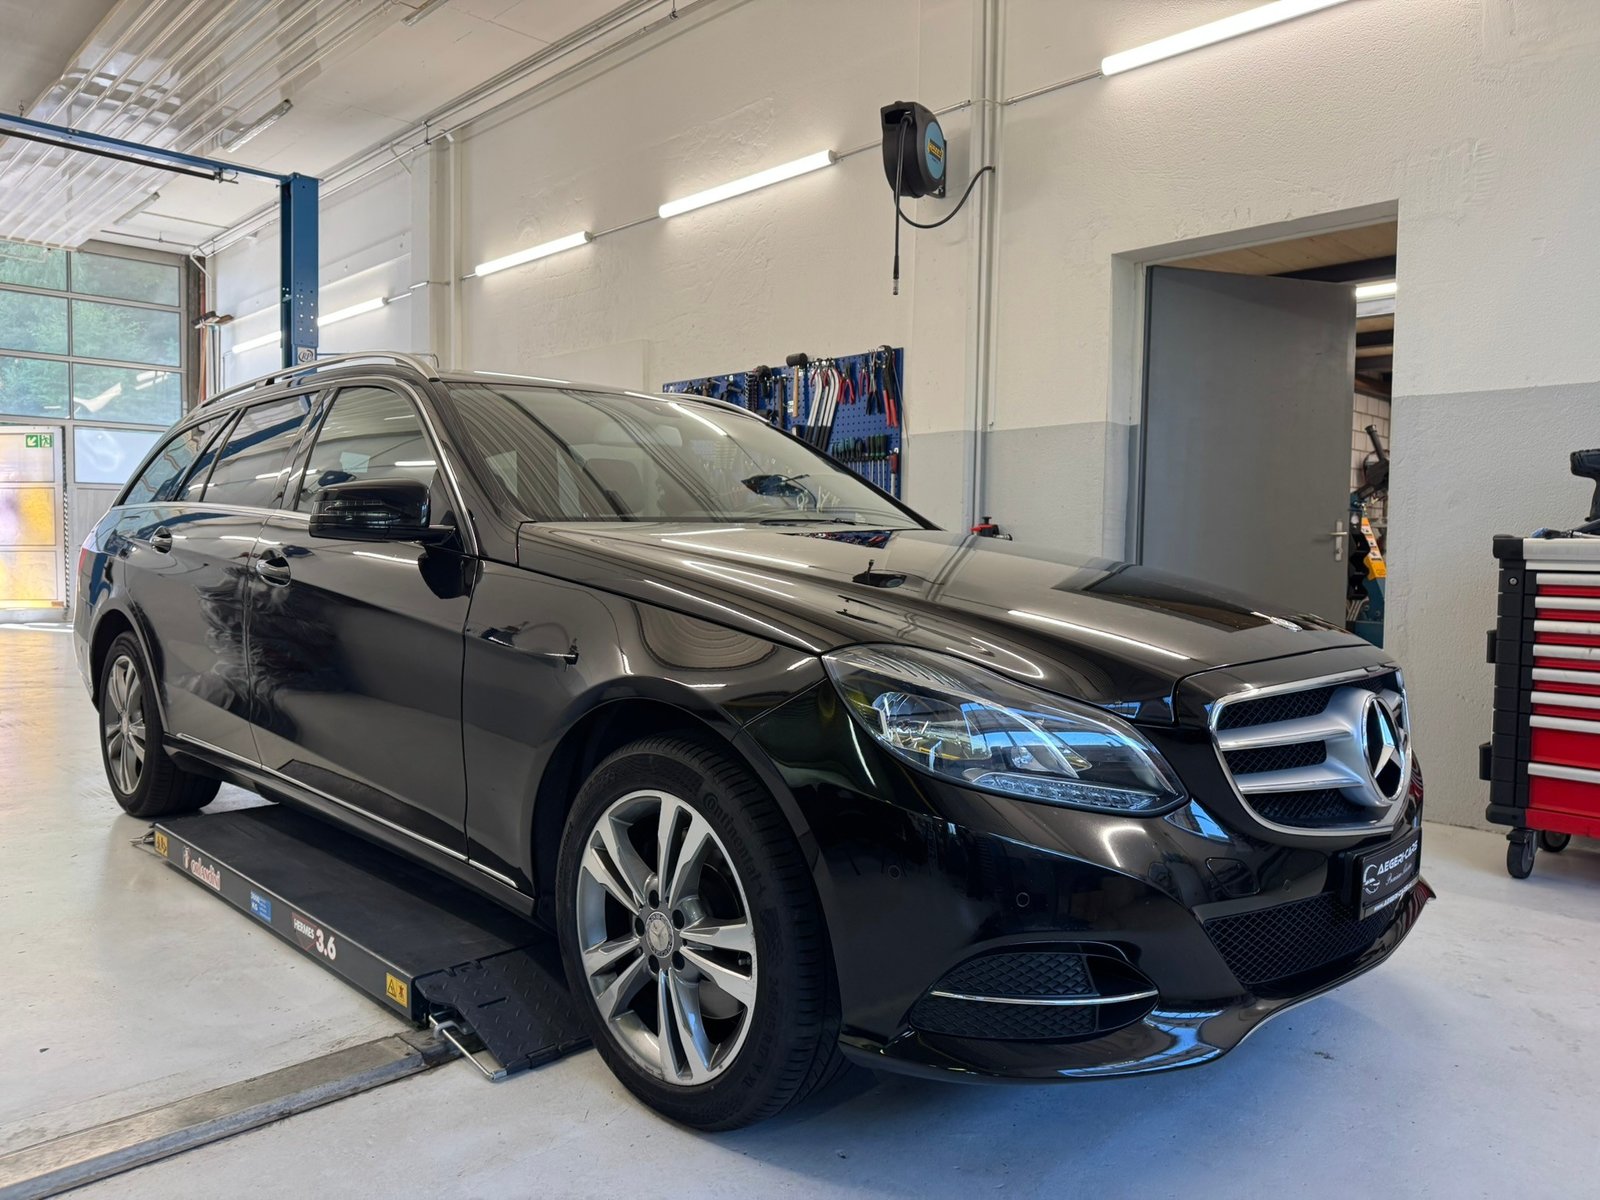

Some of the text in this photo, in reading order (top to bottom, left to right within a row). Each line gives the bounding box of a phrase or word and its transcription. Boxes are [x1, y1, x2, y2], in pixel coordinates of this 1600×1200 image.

[703, 792, 762, 882] Continental
[293, 918, 336, 960] HERMES 3.6
